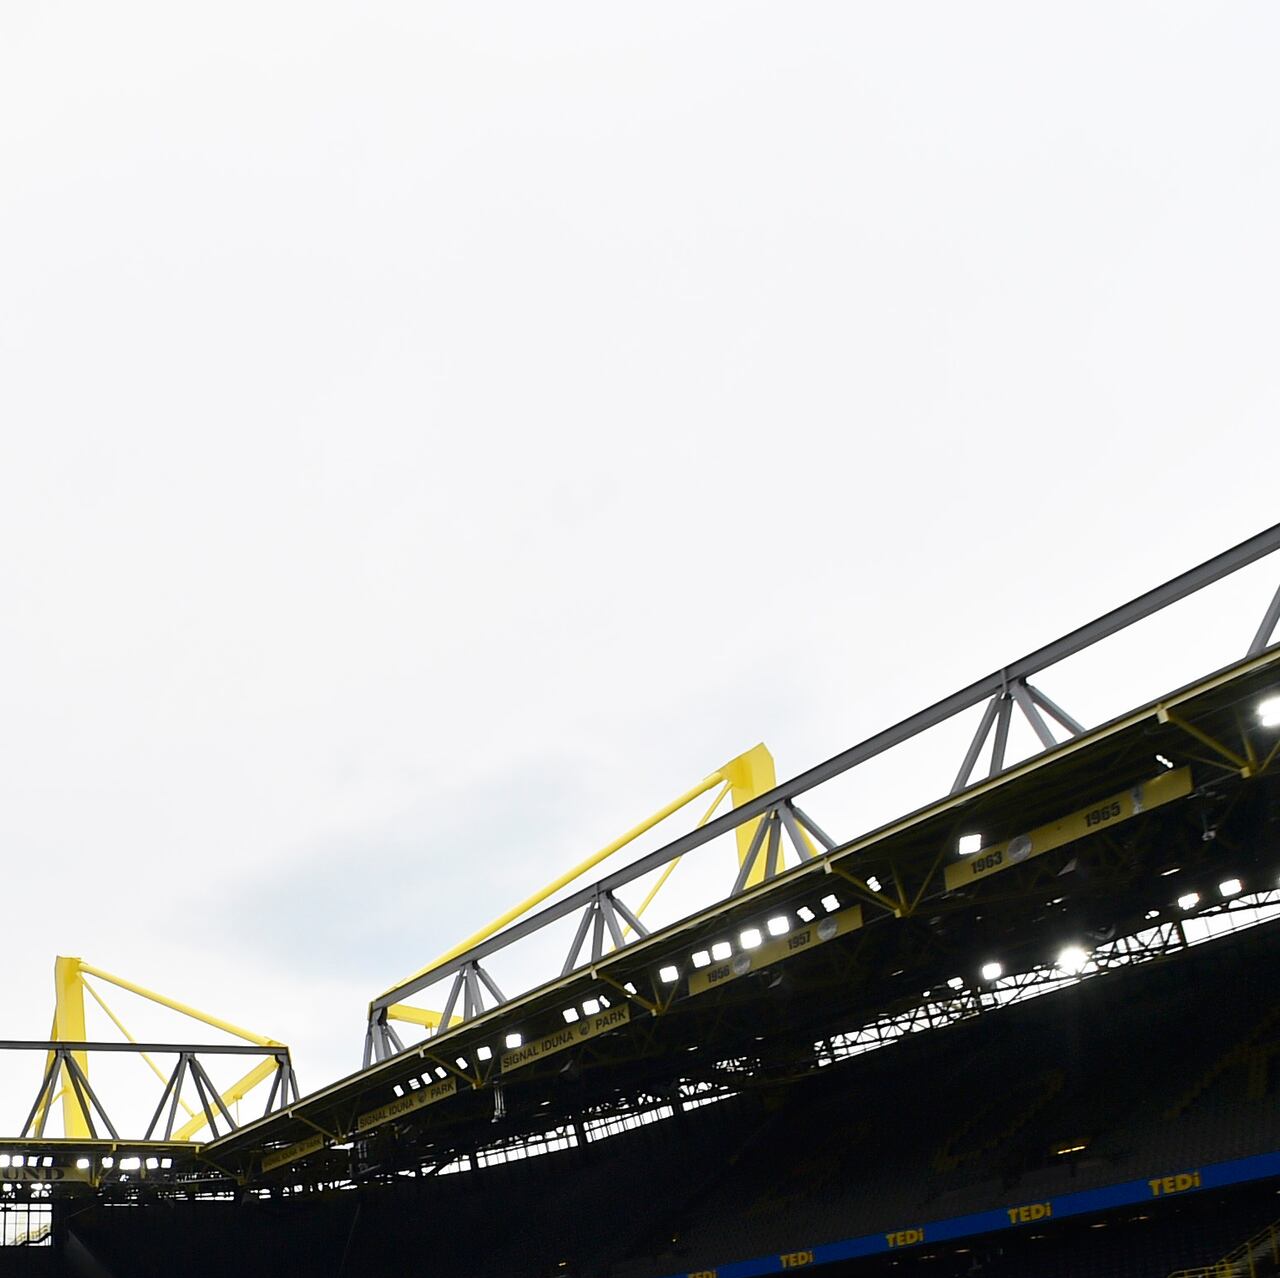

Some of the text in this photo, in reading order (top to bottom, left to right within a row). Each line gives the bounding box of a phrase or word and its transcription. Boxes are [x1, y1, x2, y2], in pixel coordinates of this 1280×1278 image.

[502, 1008, 627, 1069] SIGNAL IDUNA PARK
[430, 1081, 455, 1099] PARK
[1147, 1172, 1201, 1197] TEDi
[1007, 1202, 1051, 1225] TEDi
[885, 1228, 924, 1248] TEDi
